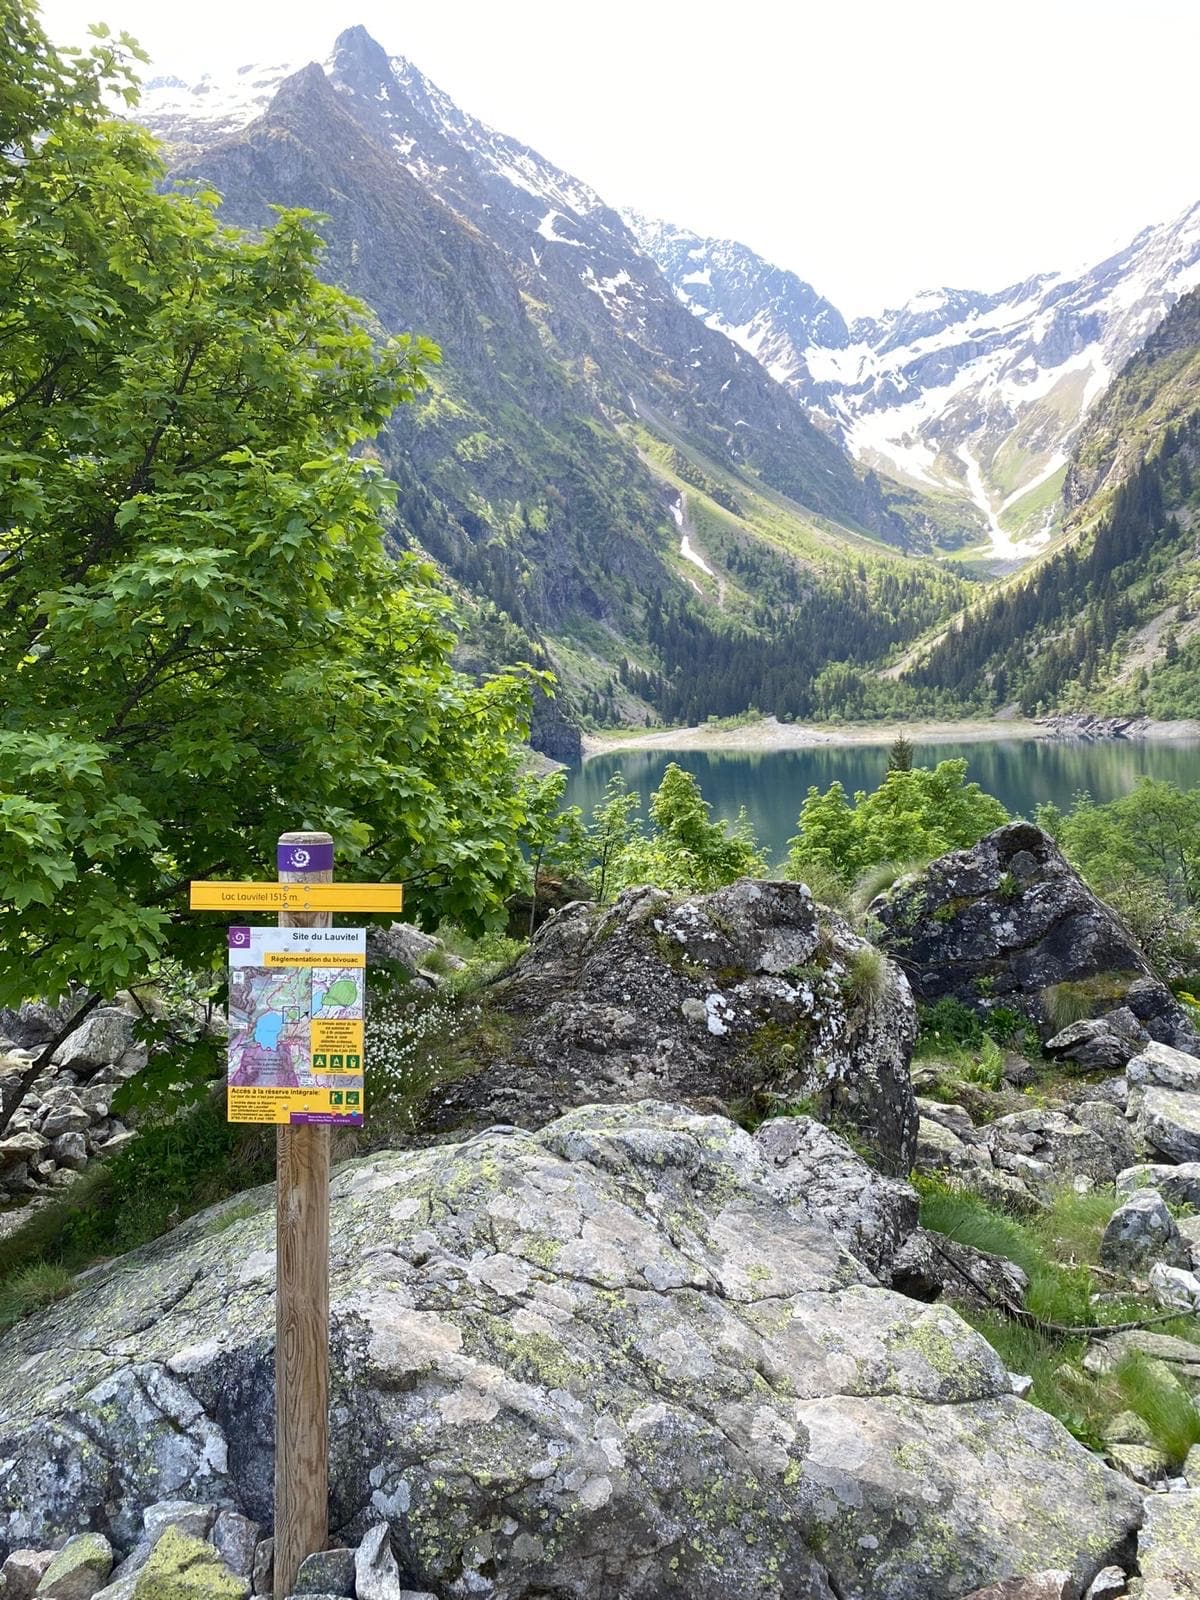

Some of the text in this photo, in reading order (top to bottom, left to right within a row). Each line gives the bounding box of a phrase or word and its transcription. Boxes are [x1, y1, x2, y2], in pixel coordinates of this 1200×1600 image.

[221, 892, 235, 901] Lac
[237, 892, 268, 901] Lauvitel
[270, 893, 287, 902] 1515
[292, 932, 359, 941] Site du Lauvitel
[271, 955, 322, 963] Réglementation
